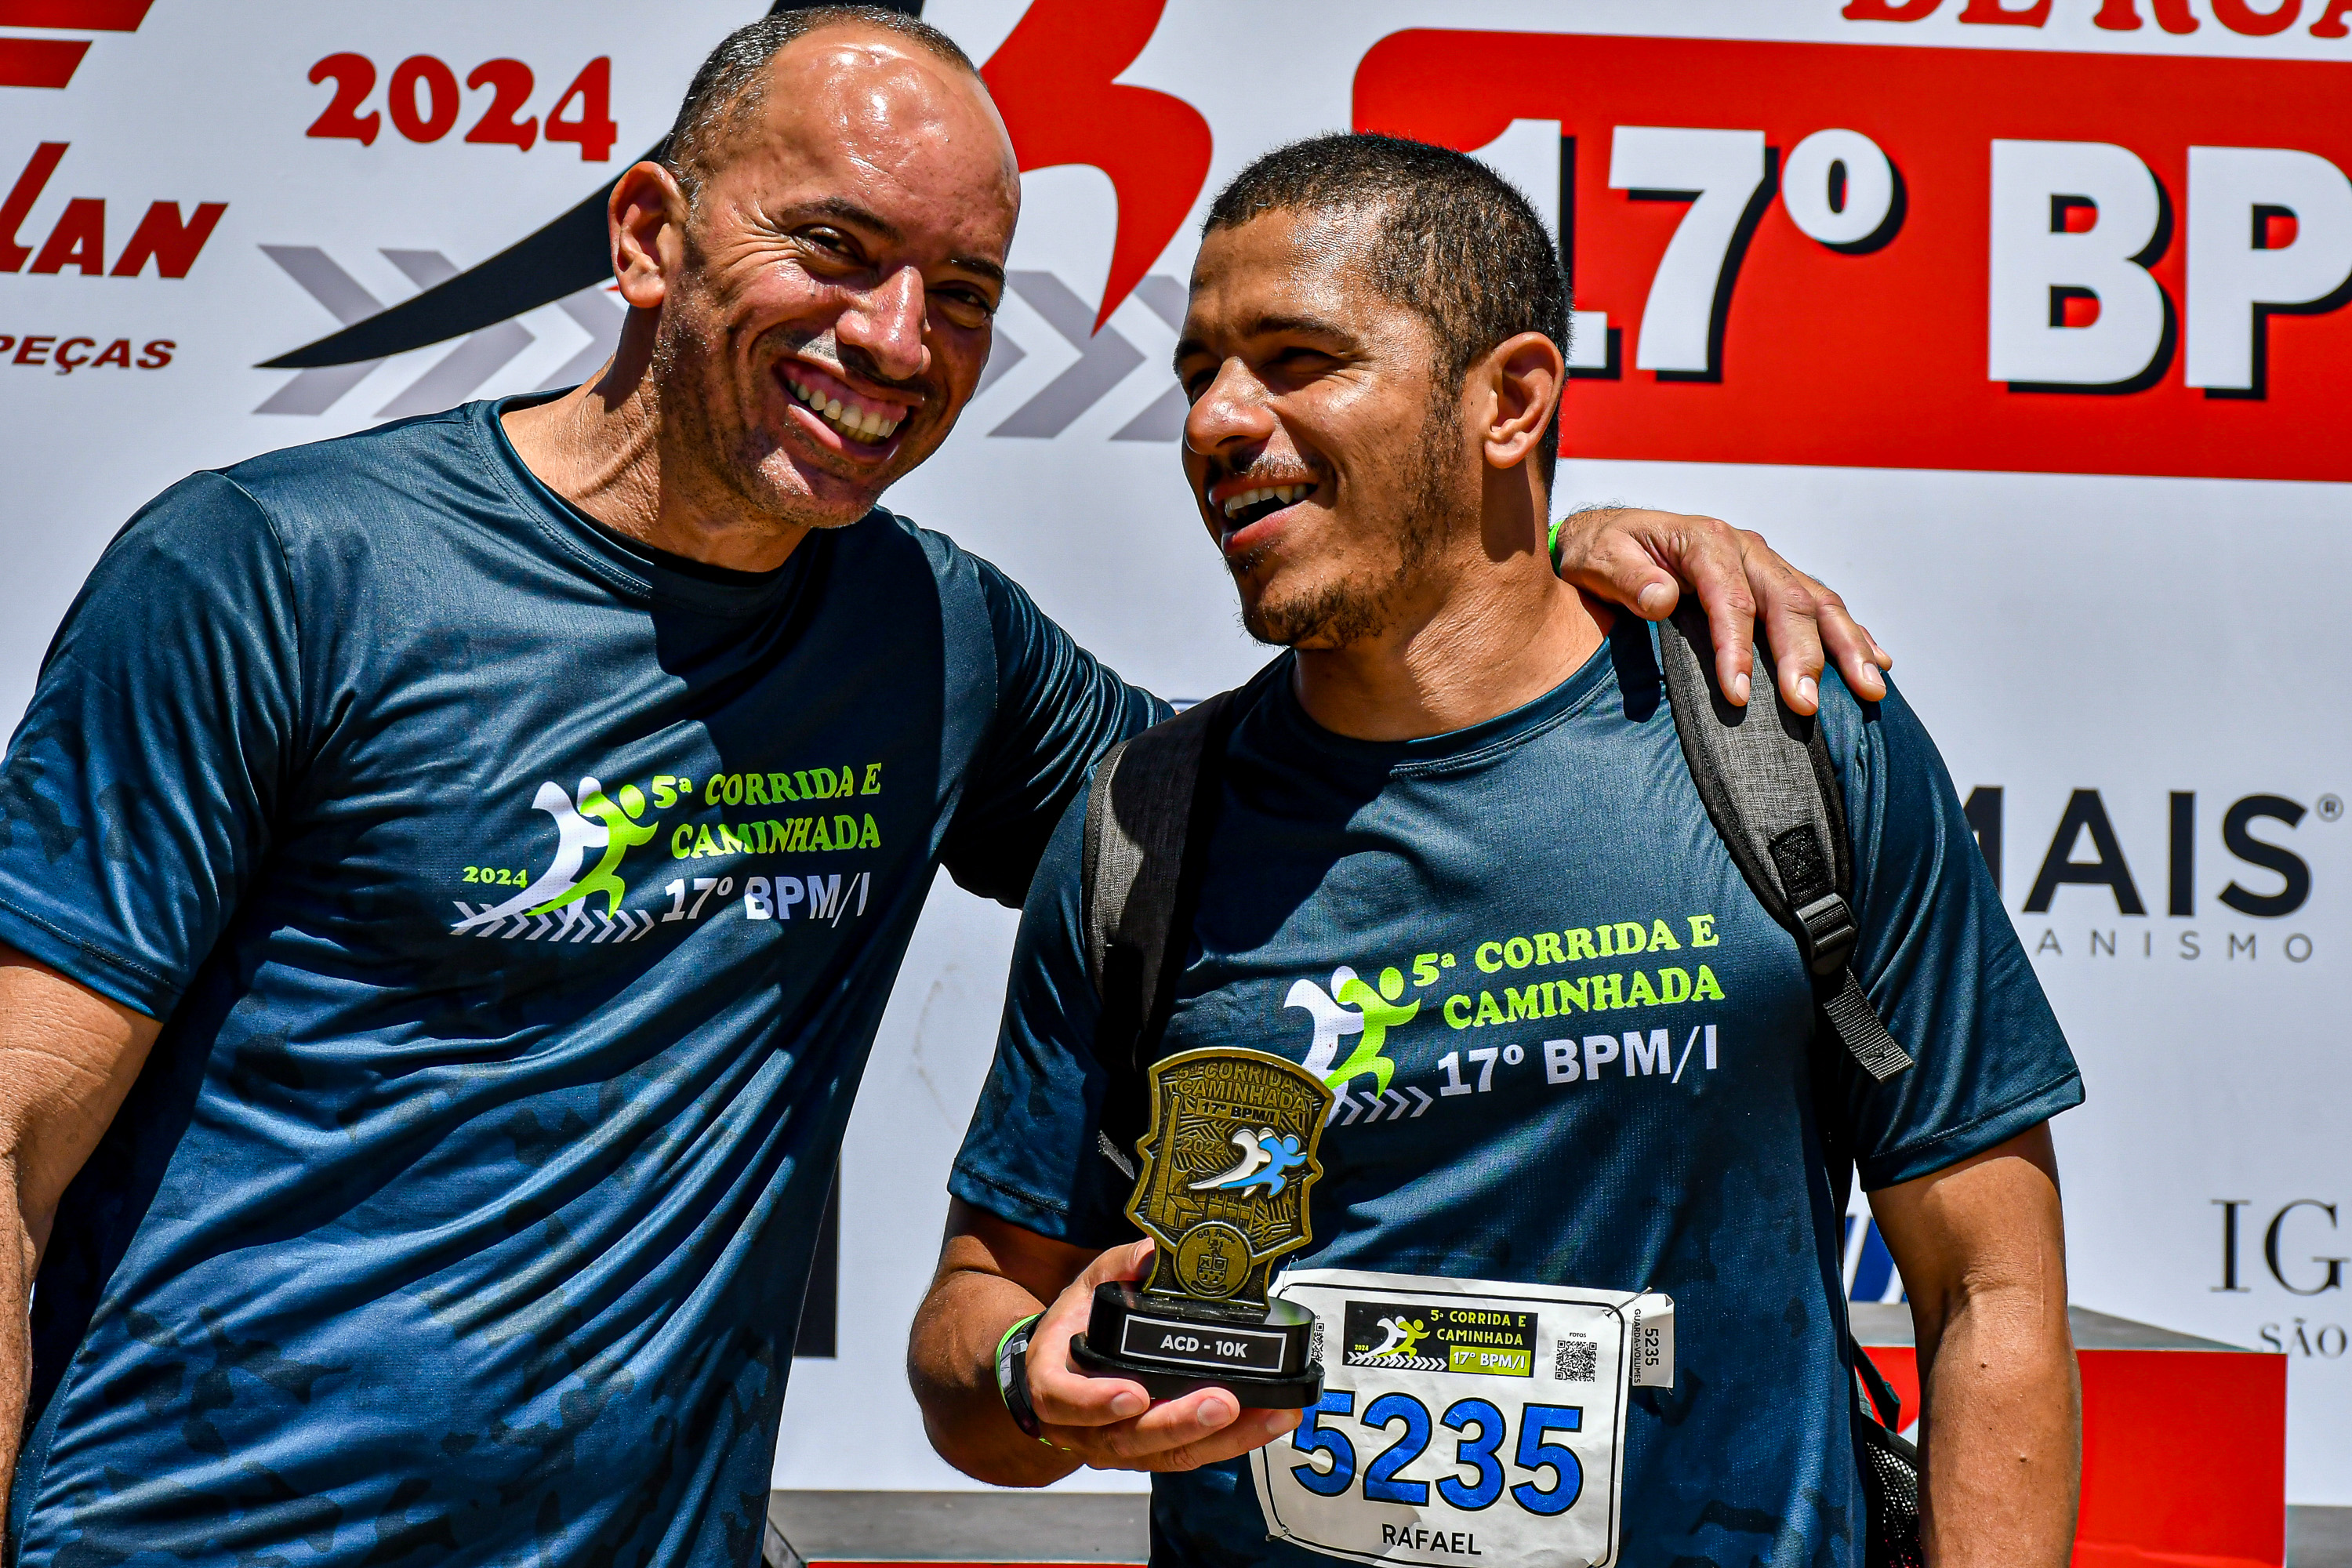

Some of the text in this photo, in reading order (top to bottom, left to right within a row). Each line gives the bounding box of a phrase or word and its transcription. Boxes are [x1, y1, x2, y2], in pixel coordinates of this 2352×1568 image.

[304, 51, 619, 162] 2024
[652, 763, 882, 809] 5ª CORRIDA E
[671, 813, 881, 860] CAMINHADA
[462, 866, 528, 888] 2024
[745, 872, 871, 928] BPM/I
[1411, 913, 1720, 987] 5ª CORRIDA E
[1443, 964, 1726, 1030] CAMINHADA
[1543, 1024, 1718, 1085] BPM/I
[1178, 1080, 1308, 1112] CAMINHADA
[1203, 1061, 1294, 1092] CORRIDA
[1181, 1138, 1227, 1156] 2024
[1196, 1229, 1210, 1240] 60
[2209, 1198, 2352, 1296] IG
[1436, 1328, 1523, 1346] CAMINHADA
[1449, 1310, 1512, 1327] CORRIDA
[1518, 1316, 1526, 1327] E
[2259, 1317, 2348, 1359] SÃO
[1160, 1334, 1200, 1352] ACD
[1215, 1340, 1248, 1358] 10K
[1480, 1354, 1526, 1370] BPM/I
[1633, 1308, 1642, 1384] GUARDA-VOLUMES
[1644, 1328, 1660, 1367] 5235
[1289, 1388, 1584, 1517] 5235
[1381, 1523, 1482, 1556] RAFAEL
